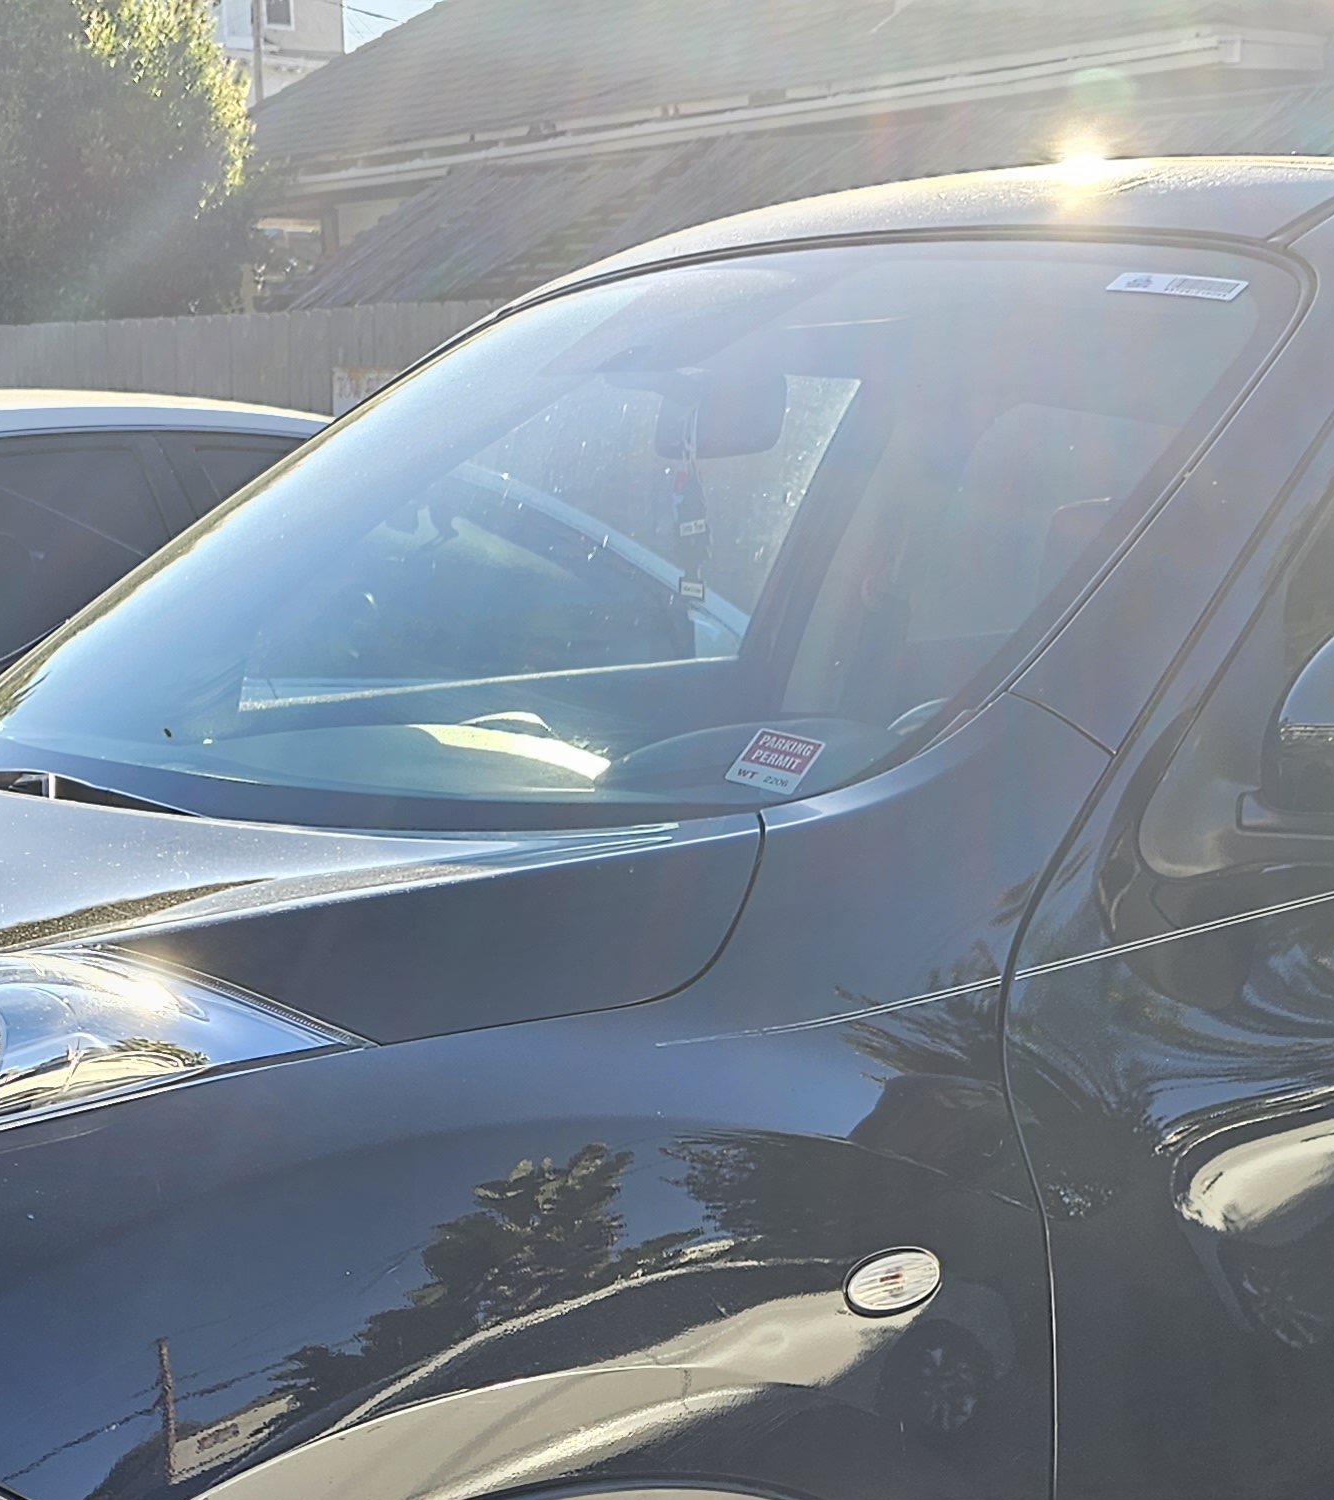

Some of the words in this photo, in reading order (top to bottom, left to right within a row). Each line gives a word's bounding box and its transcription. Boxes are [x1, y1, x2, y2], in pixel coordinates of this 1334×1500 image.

[758, 734, 814, 756] PARKING
[751, 749, 802, 770] PERMIT
[737, 768, 758, 779] WT
